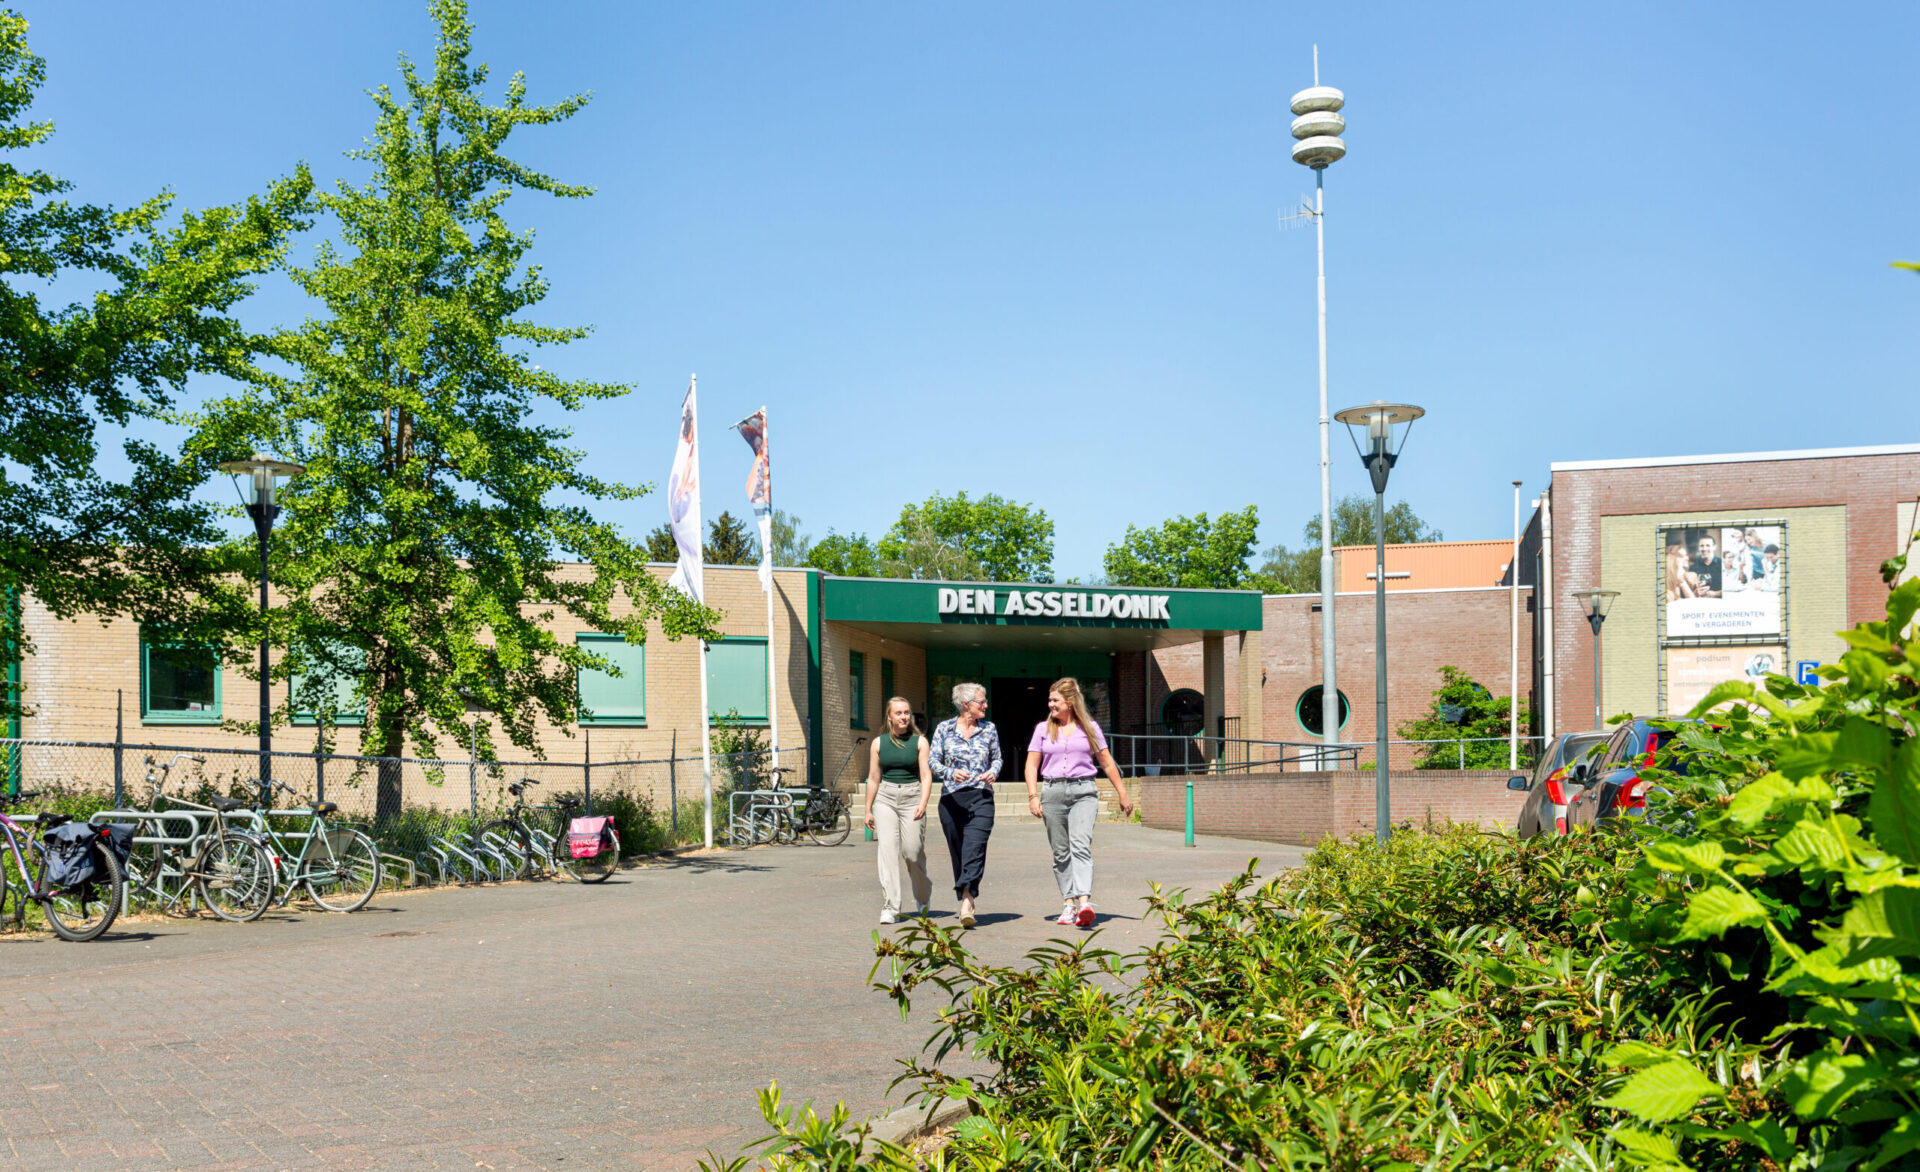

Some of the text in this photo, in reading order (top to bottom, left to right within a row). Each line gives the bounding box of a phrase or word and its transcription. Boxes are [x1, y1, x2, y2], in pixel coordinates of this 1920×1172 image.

[938, 588, 1171, 620] DEN ASSELDONK
[1703, 620, 1752, 628] VERGADEREN
[1696, 654, 1731, 664] podium
[1802, 664, 1816, 682] P
